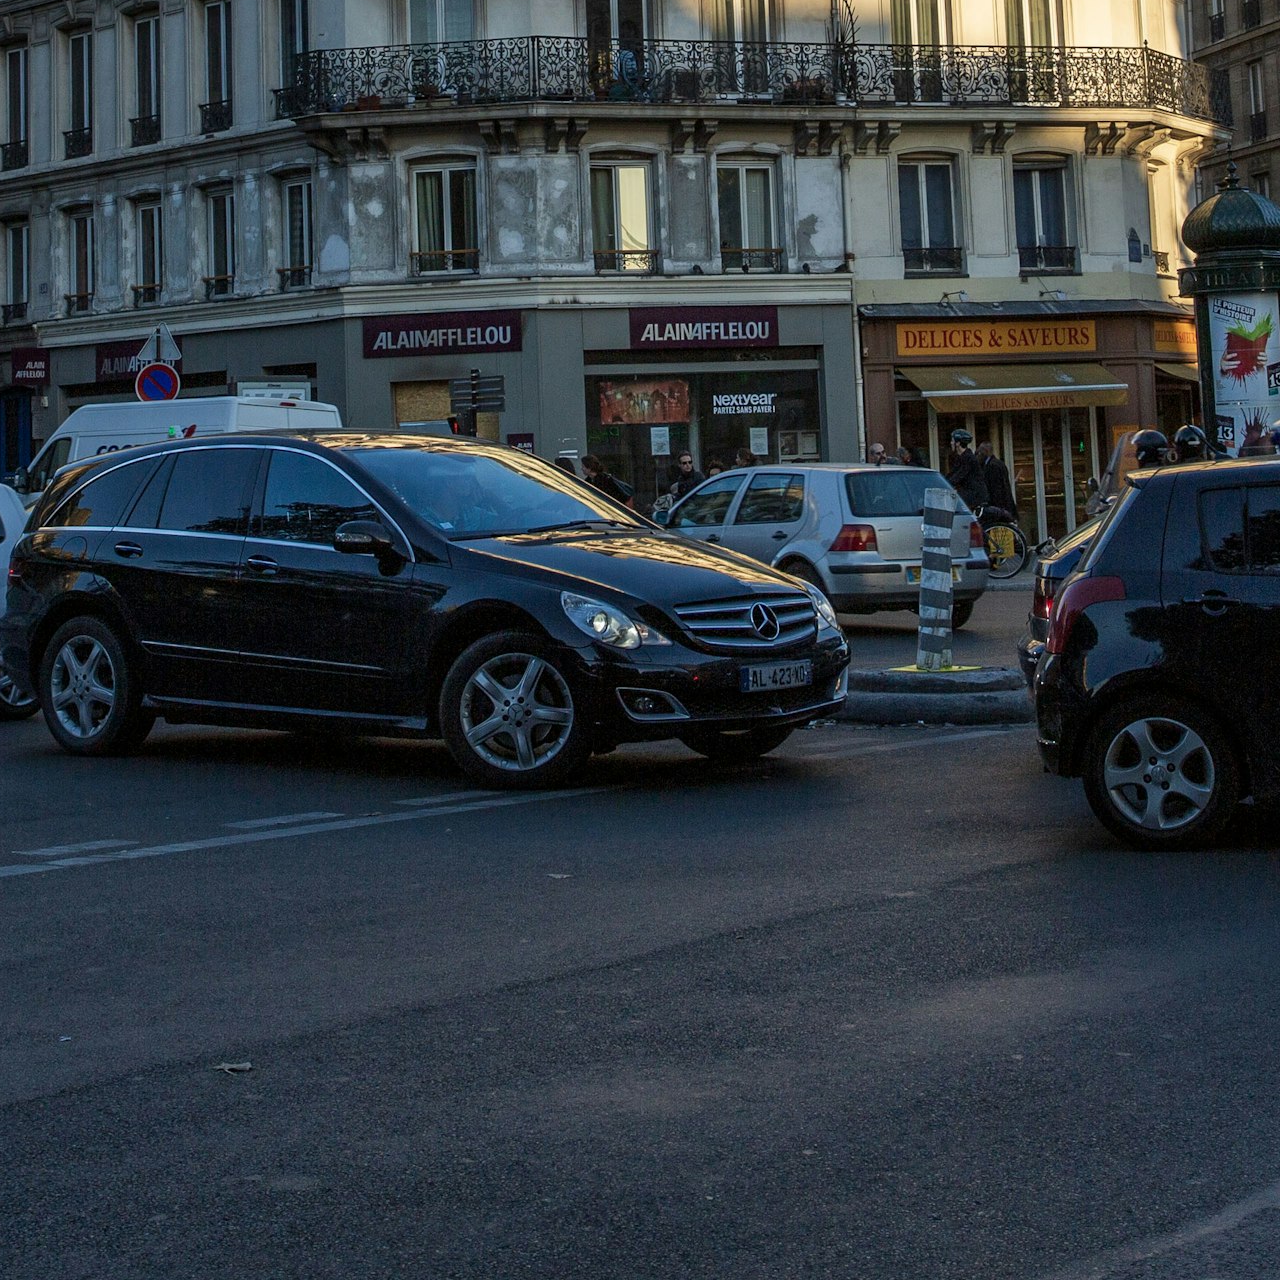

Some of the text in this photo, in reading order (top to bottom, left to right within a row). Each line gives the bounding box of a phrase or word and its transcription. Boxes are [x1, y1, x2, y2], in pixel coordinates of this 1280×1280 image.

[1214, 298, 1256, 316] LE PORTEUR
[1213, 306, 1252, 323] D'HISTOIRE
[904, 327, 1090, 349] DELICES & SAVEURS
[25, 361, 46, 369] ALAIN
[15, 370, 46, 379] AFFLELOU
[982, 398, 1021, 410] DELICES
[1033, 395, 1075, 407] SAVEURS
[713, 406, 735, 415] PARTEZ
[736, 406, 753, 414] SANS
[753, 405, 772, 413] PAYER
[1217, 426, 1234, 440] 13
